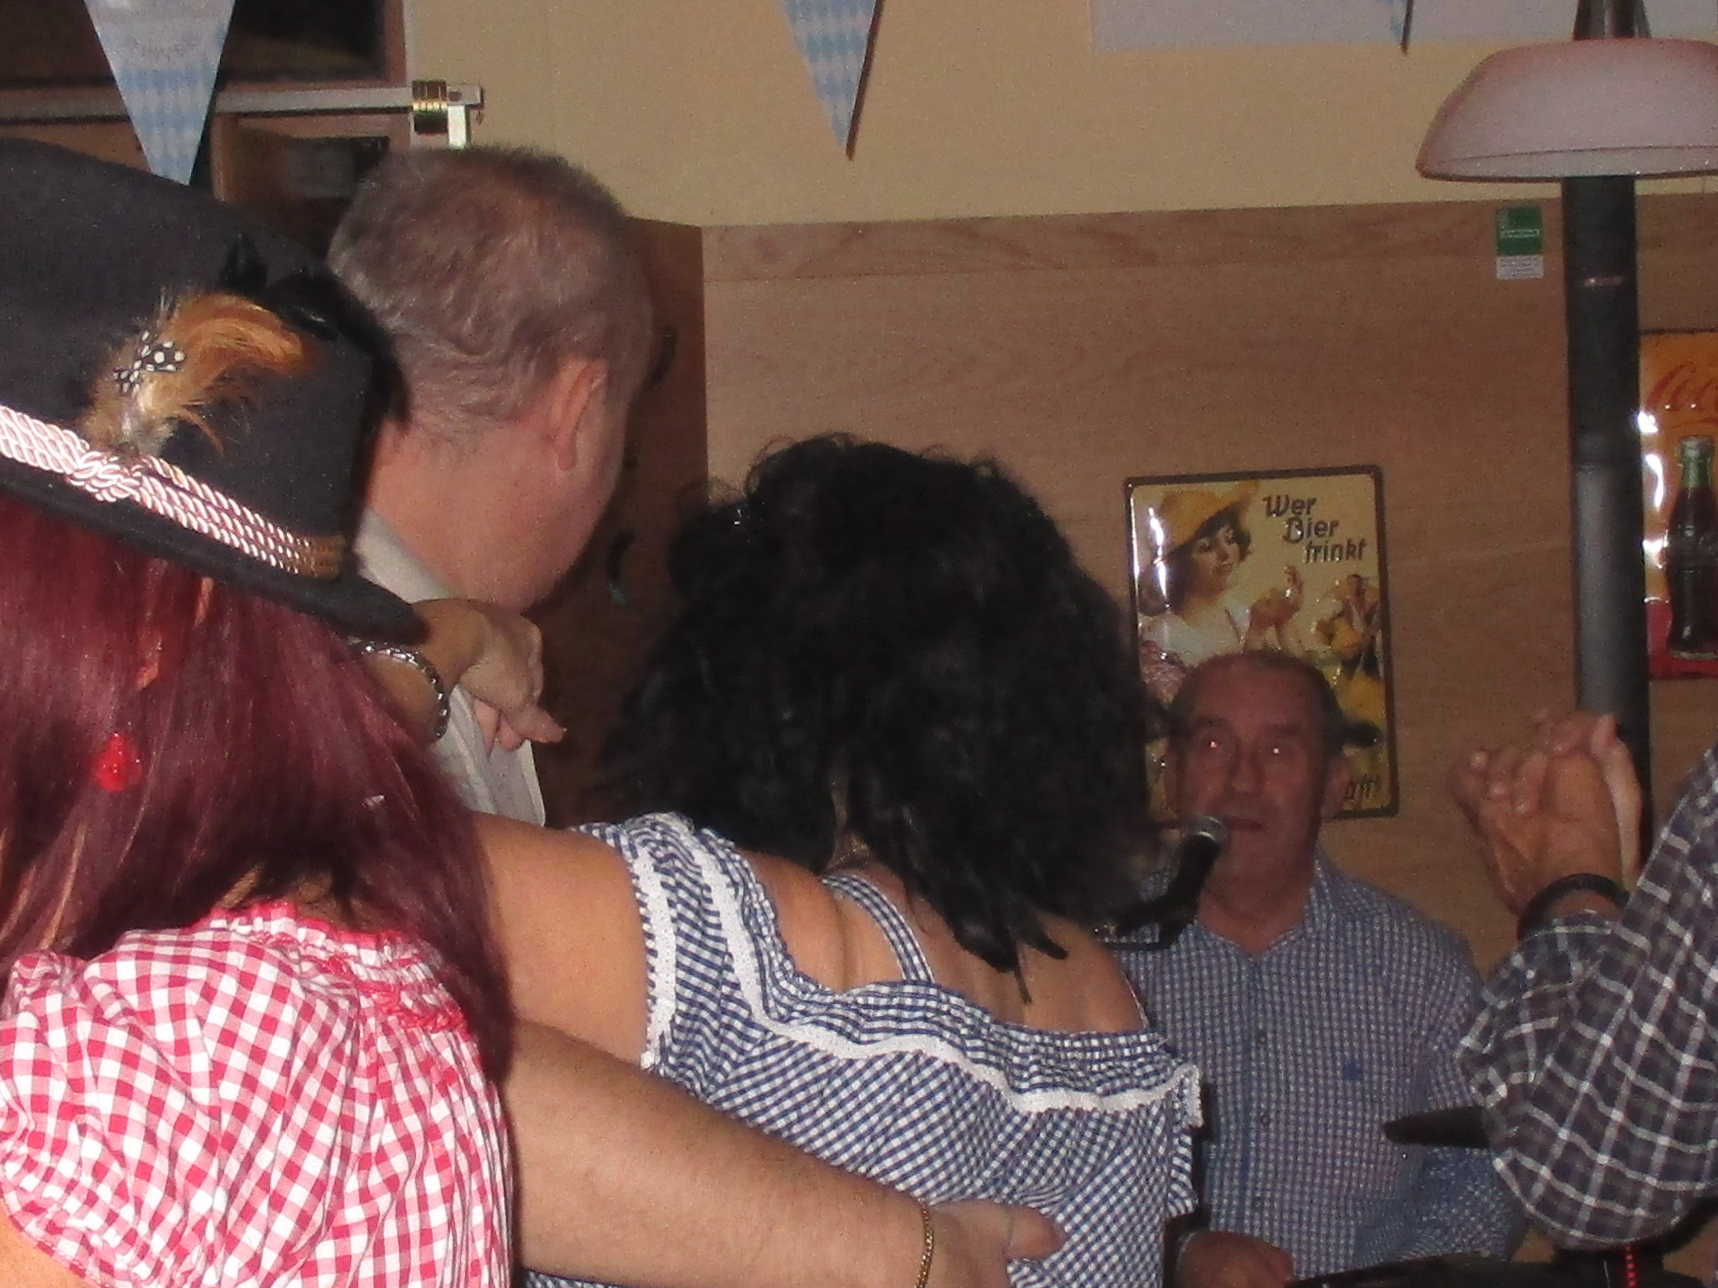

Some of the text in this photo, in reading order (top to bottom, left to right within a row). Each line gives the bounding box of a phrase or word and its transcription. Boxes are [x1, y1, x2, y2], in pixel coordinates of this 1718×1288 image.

[1263, 493, 1317, 518] Wer
[1283, 517, 1340, 543] Bier
[1304, 538, 1368, 564] trinkt
